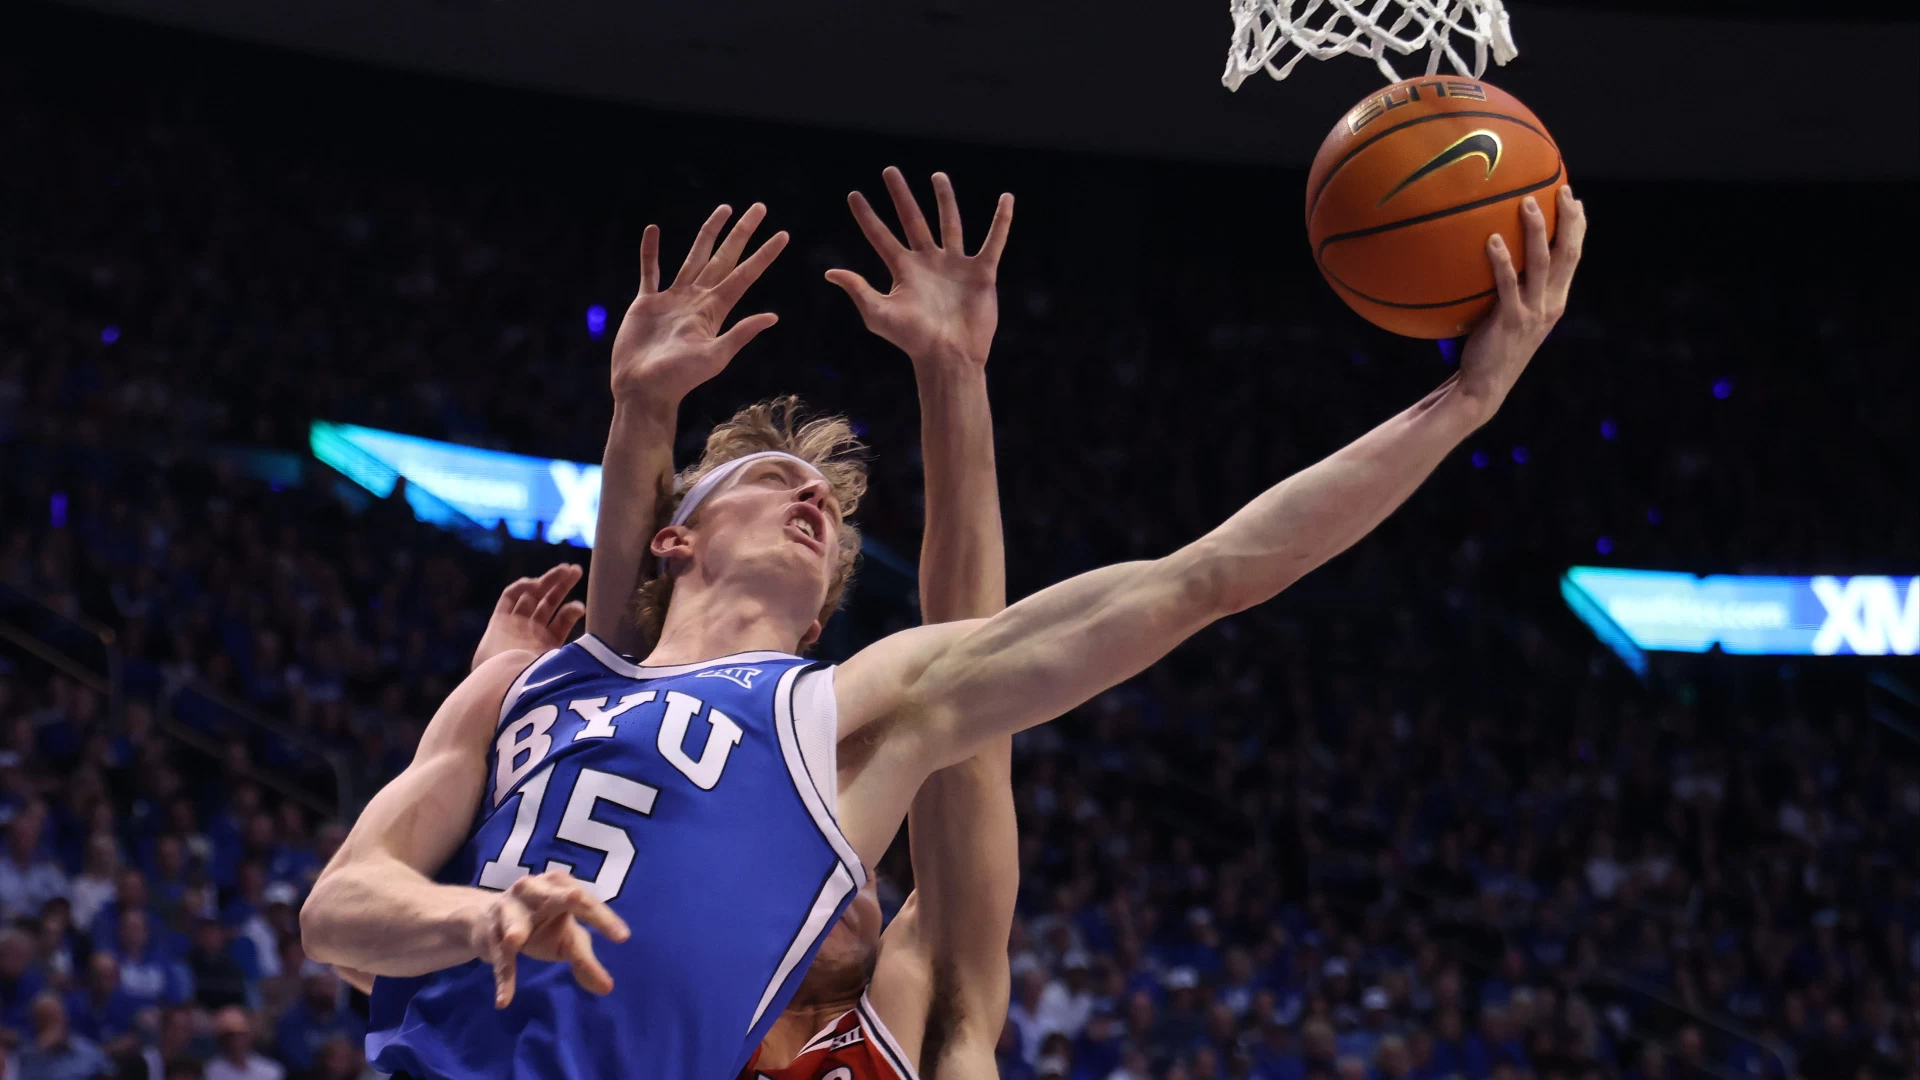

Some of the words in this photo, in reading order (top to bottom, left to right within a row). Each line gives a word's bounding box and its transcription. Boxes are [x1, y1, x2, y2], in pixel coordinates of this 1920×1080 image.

[1347, 81, 1487, 136] ELITE
[493, 689, 745, 808] BYU
[478, 761, 661, 904] 15
